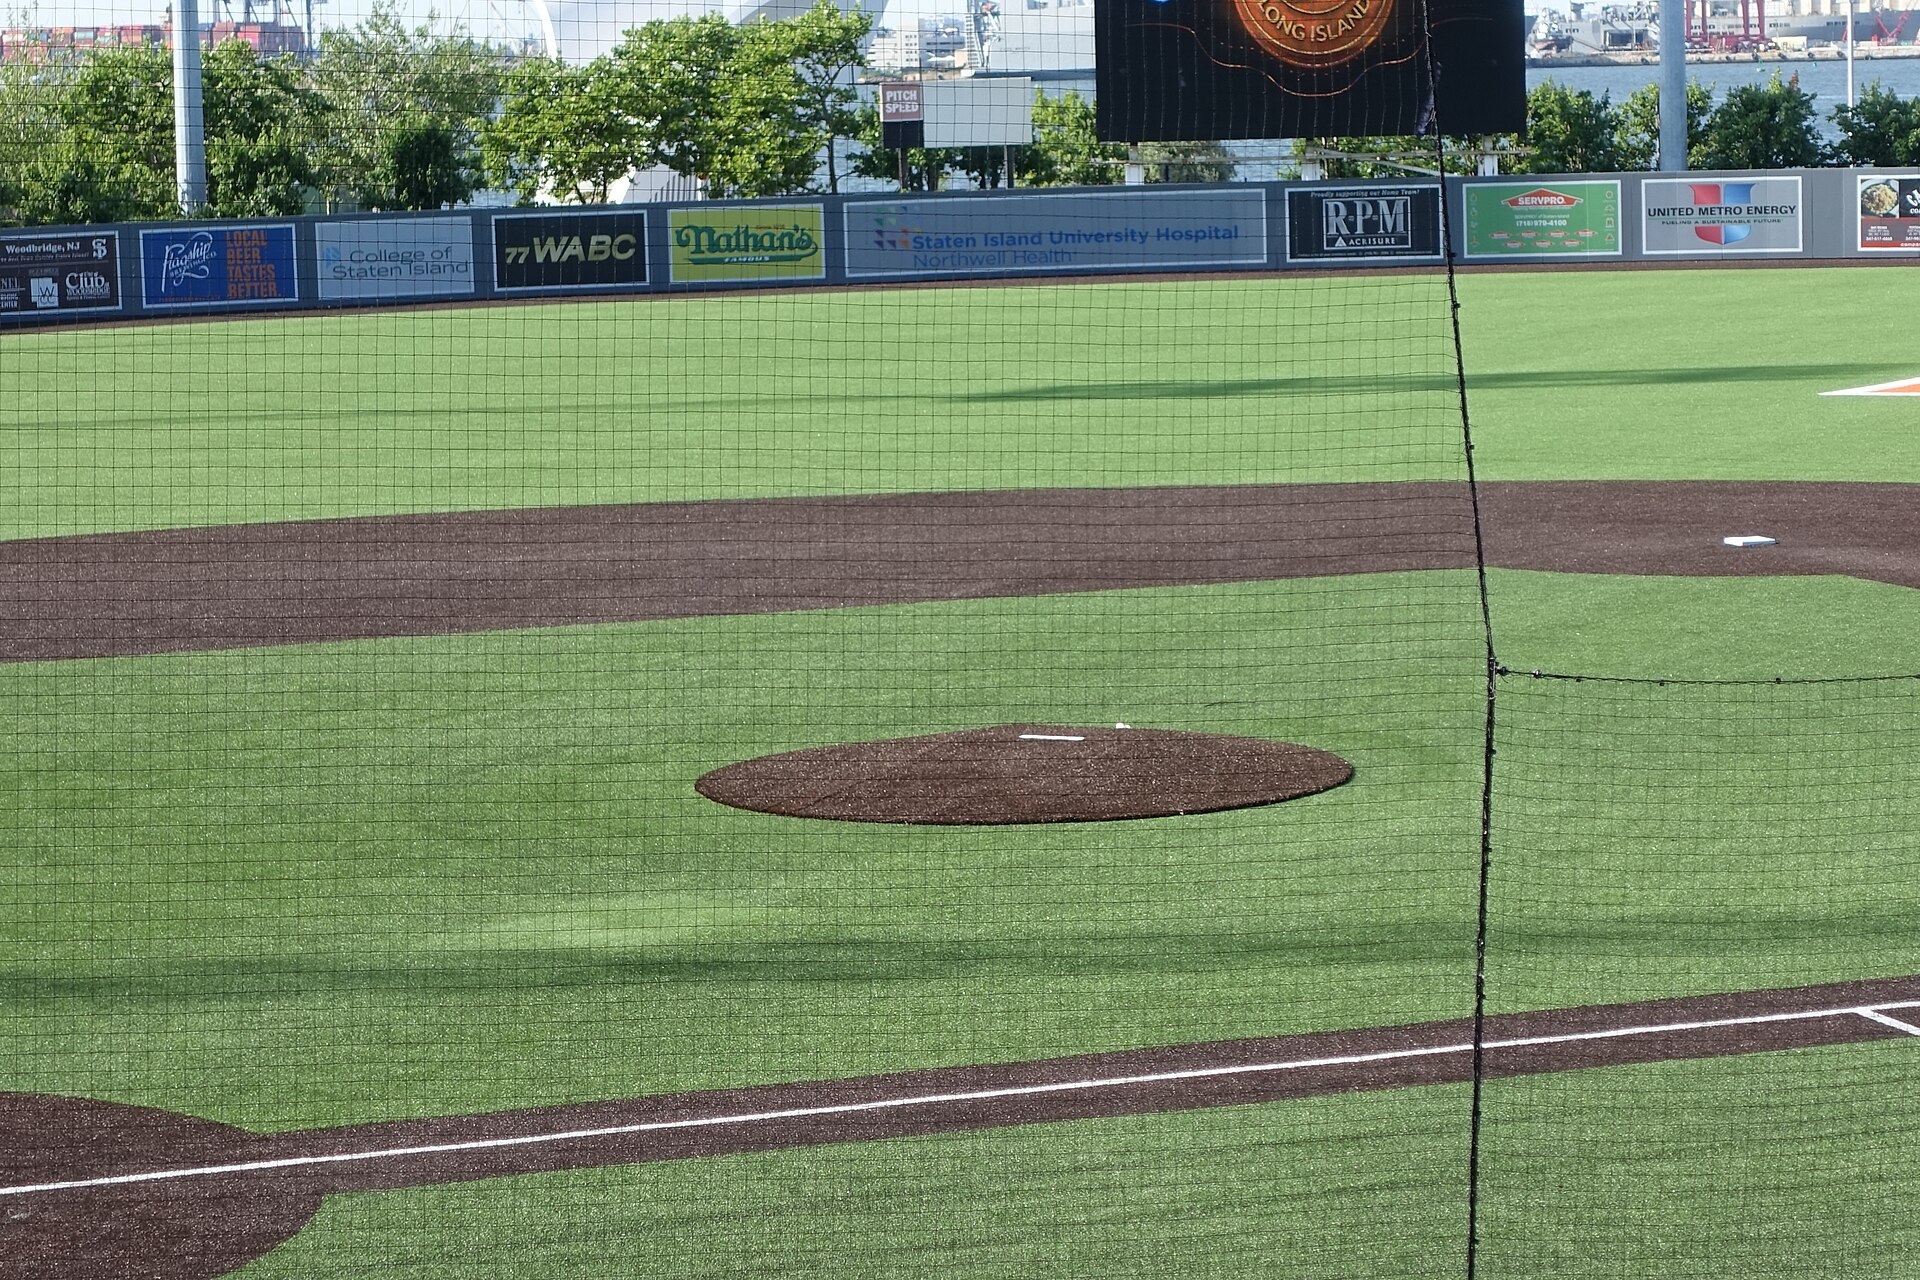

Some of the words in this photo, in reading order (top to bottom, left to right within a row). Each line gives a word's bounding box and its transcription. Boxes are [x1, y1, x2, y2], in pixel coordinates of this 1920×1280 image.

[1257, 0, 1305, 41] LONG
[1310, 0, 1371, 42] ISLAND
[885, 89, 917, 101] PITCH
[885, 102, 919, 113] SPEED
[1647, 207, 1694, 217] UNITED
[1698, 206, 1742, 216] METRO
[1747, 205, 1797, 215] ENERGY
[226, 230, 268, 247] LOCAL
[675, 224, 813, 254] Nathan's
[912, 234, 977, 250] Staten
[984, 232, 1042, 247] Island
[1050, 227, 1149, 245] University
[1157, 225, 1239, 243] Hospital
[1348, 237, 1396, 246] ACRISURE
[5, 242, 65, 254] Woodbridge,
[66, 241, 81, 252] NJ
[226, 247, 262, 265] BEER
[350, 248, 425, 265] College
[431, 245, 452, 260] of
[505, 246, 530, 264] 77
[533, 233, 637, 263] WABC
[161, 231, 213, 294] Flagship
[723, 255, 771, 263] FAMOUS
[913, 251, 1006, 268] Northwell
[1013, 248, 1073, 264] Health
[226, 264, 276, 282] TASTES
[333, 264, 402, 279] Staten
[405, 260, 470, 276] Island
[227, 282, 282, 299] BETTER.
